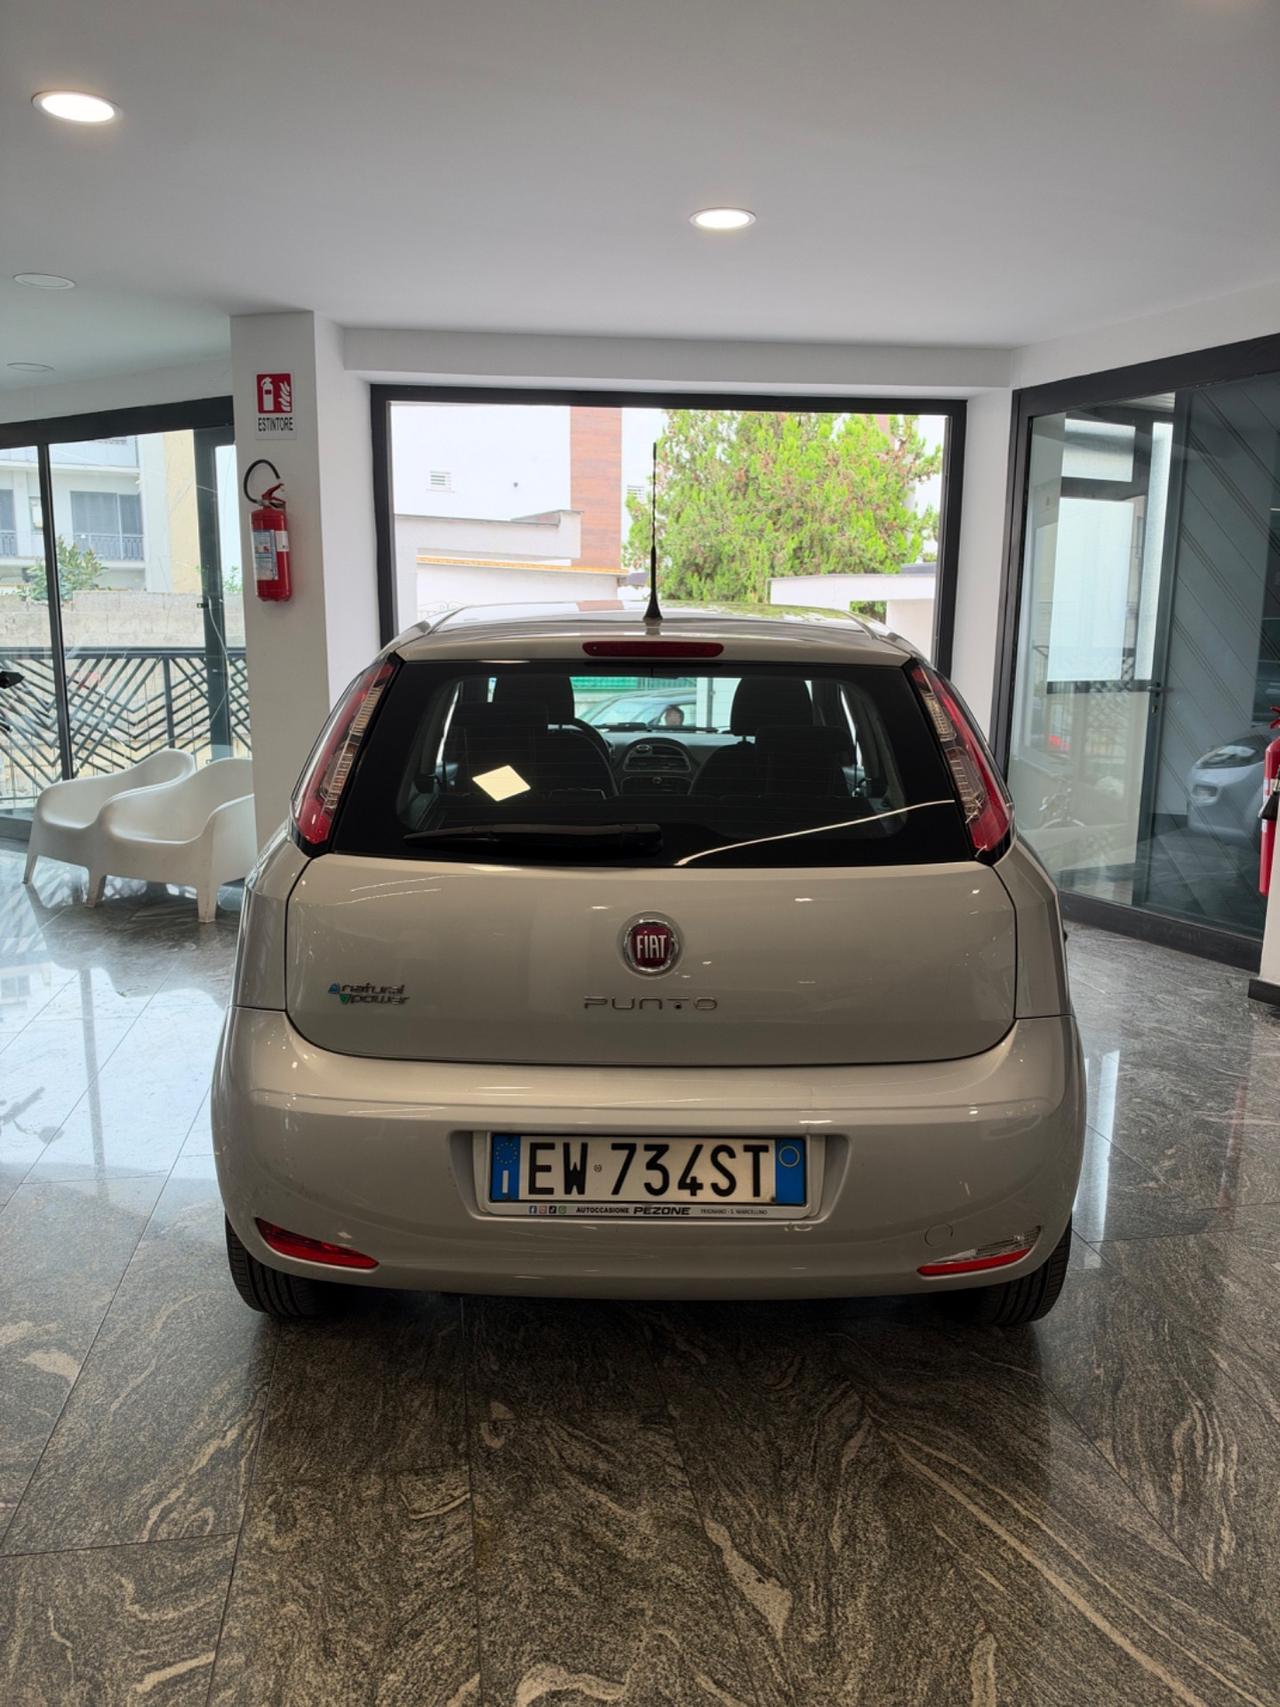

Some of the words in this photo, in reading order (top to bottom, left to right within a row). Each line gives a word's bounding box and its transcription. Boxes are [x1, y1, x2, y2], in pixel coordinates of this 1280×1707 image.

[257, 416, 294, 432] ESTINTORE
[636, 934, 668, 959] FIAT
[341, 982, 405, 995] natural
[583, 996, 718, 1011] PUNTO
[528, 1142, 589, 1196] EW
[610, 1143, 769, 1198] 734ST
[576, 1205, 630, 1214] AUTOCCASIONE
[633, 1206, 691, 1216] PEZONE
